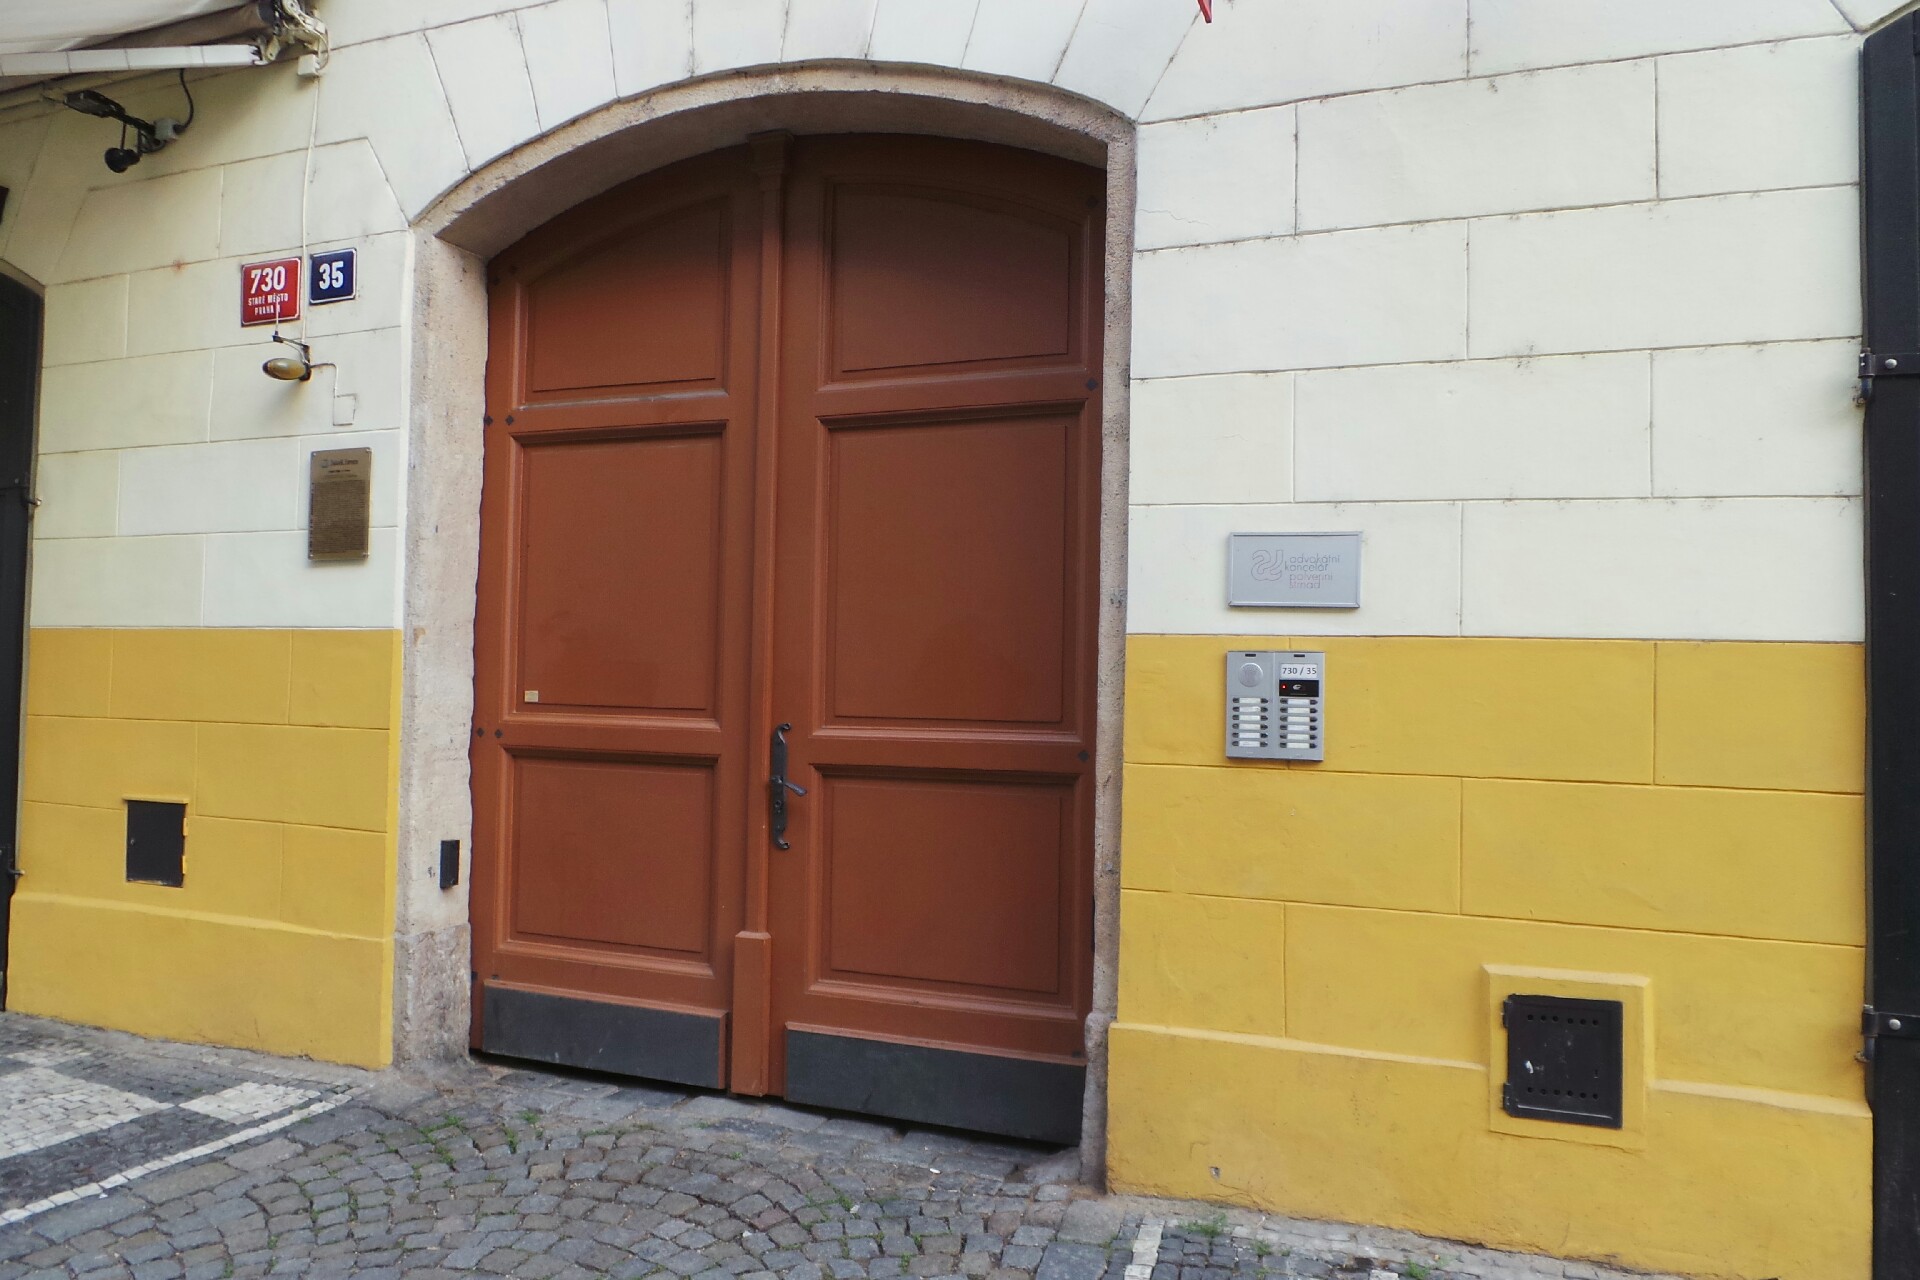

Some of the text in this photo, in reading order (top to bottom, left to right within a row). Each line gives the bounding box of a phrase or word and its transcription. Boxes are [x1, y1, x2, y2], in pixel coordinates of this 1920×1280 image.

[250, 266, 286, 294] 730
[319, 261, 344, 290] 35
[248, 293, 289, 306] STARÉ MĚSTO
[254, 305, 275, 316] PRAHA
[1282, 666, 1317, 676] 730 / 35
